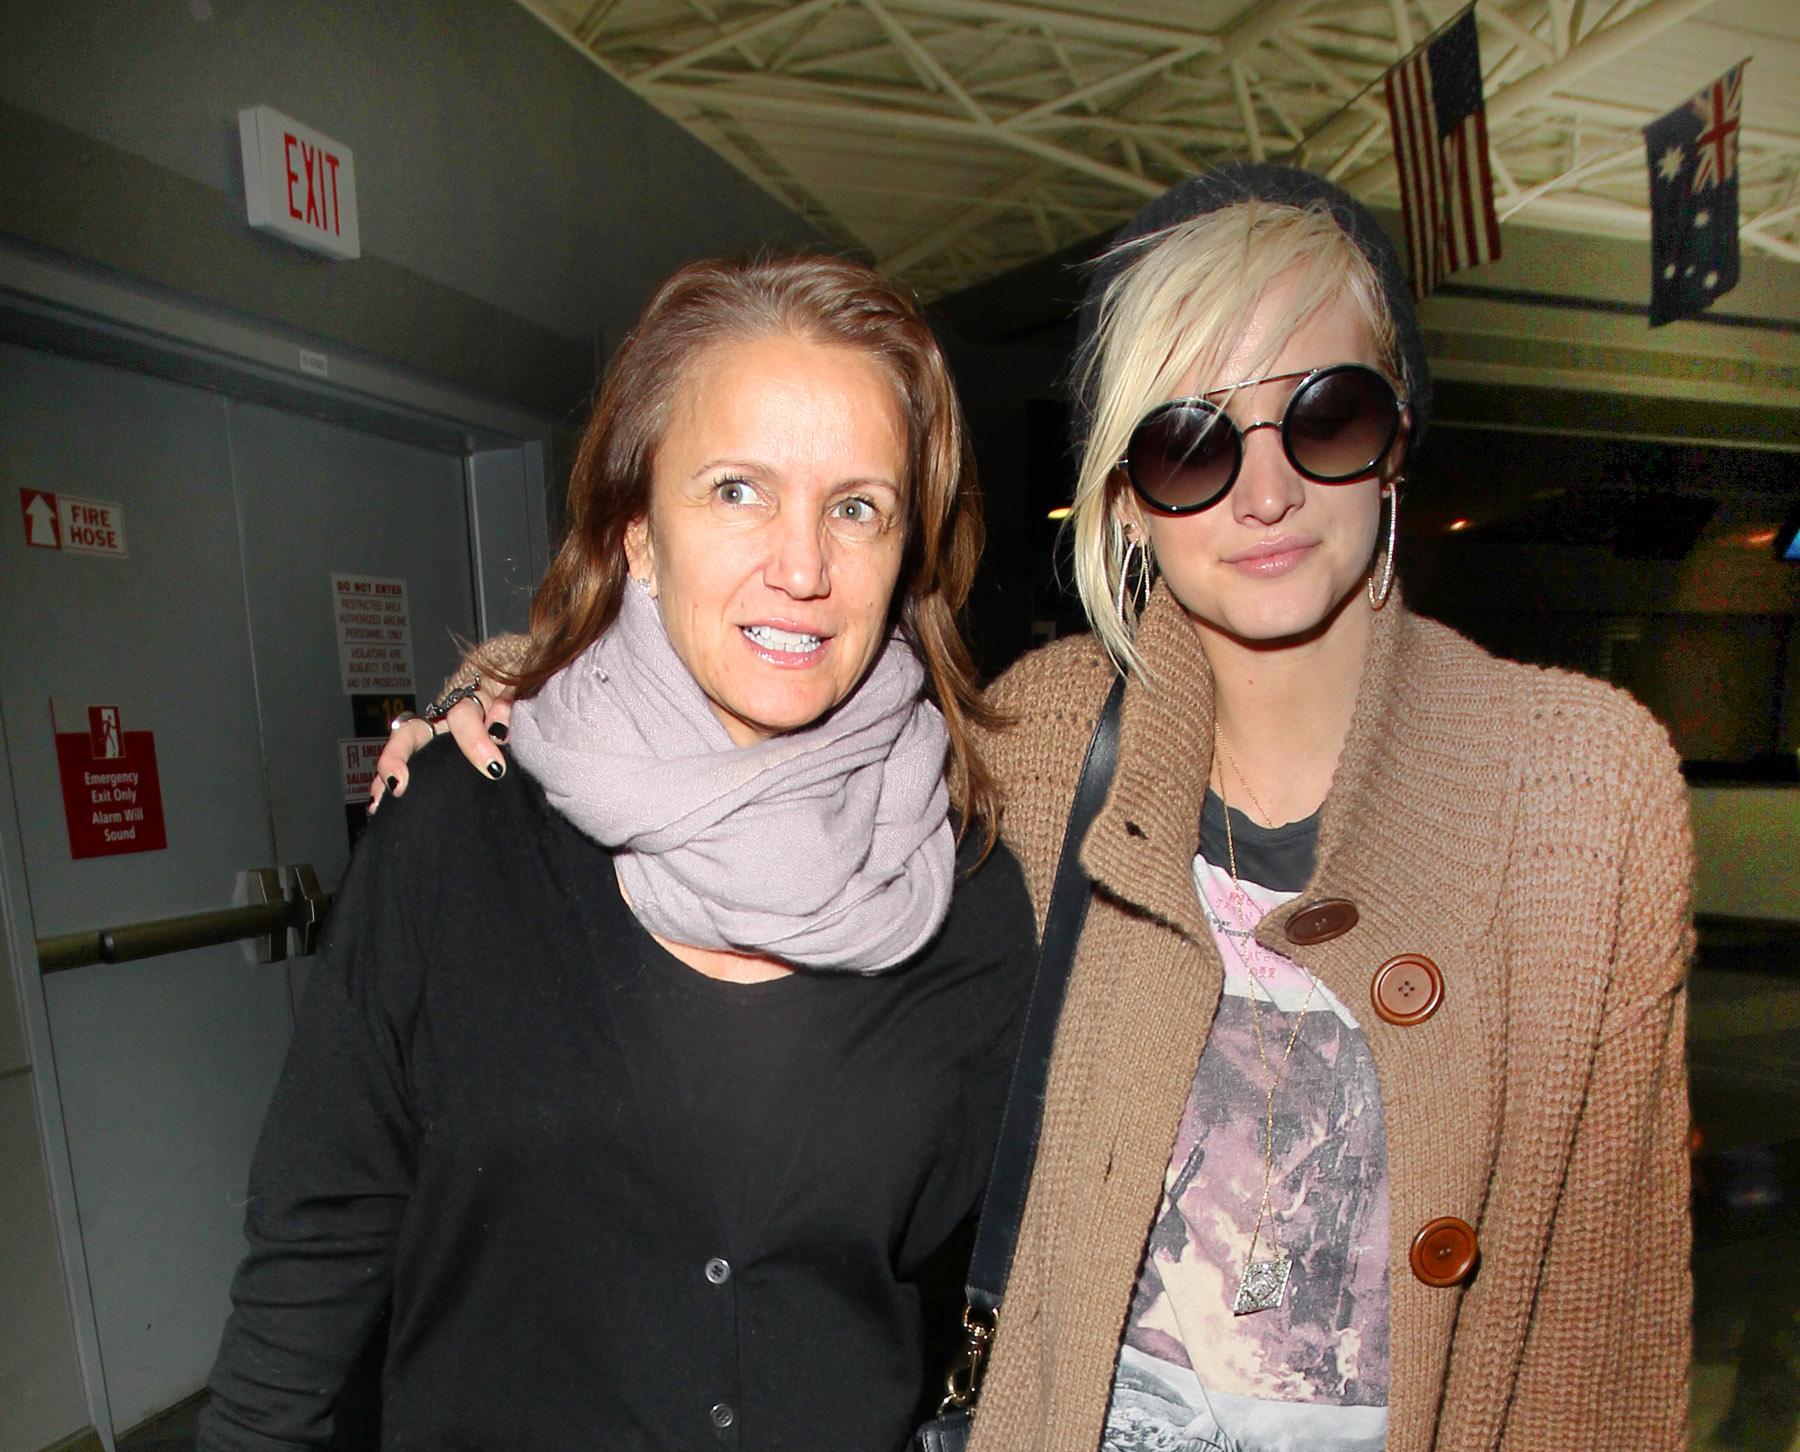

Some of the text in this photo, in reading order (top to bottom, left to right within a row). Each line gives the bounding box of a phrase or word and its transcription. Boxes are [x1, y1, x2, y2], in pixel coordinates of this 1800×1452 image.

[284, 132, 340, 236] EXIT
[71, 504, 111, 528] FIRE
[70, 525, 118, 549] HOSE
[337, 580, 402, 595] DO NOT ENTER
[341, 598, 401, 612] RESTRICTED AREA
[339, 613, 381, 625] AUTHORIZED
[345, 627, 402, 640] PERSONNEL ONLY
[351, 647, 402, 660] VIOLATORS ARE
[349, 662, 406, 673] SUBJECT TO FINE
[371, 677, 411, 689] PROSECUTION
[84, 771, 139, 787] Emergency
[91, 786, 137, 804] Exit Only
[92, 806, 144, 824] Alarm Will
[104, 825, 136, 842] Sound
